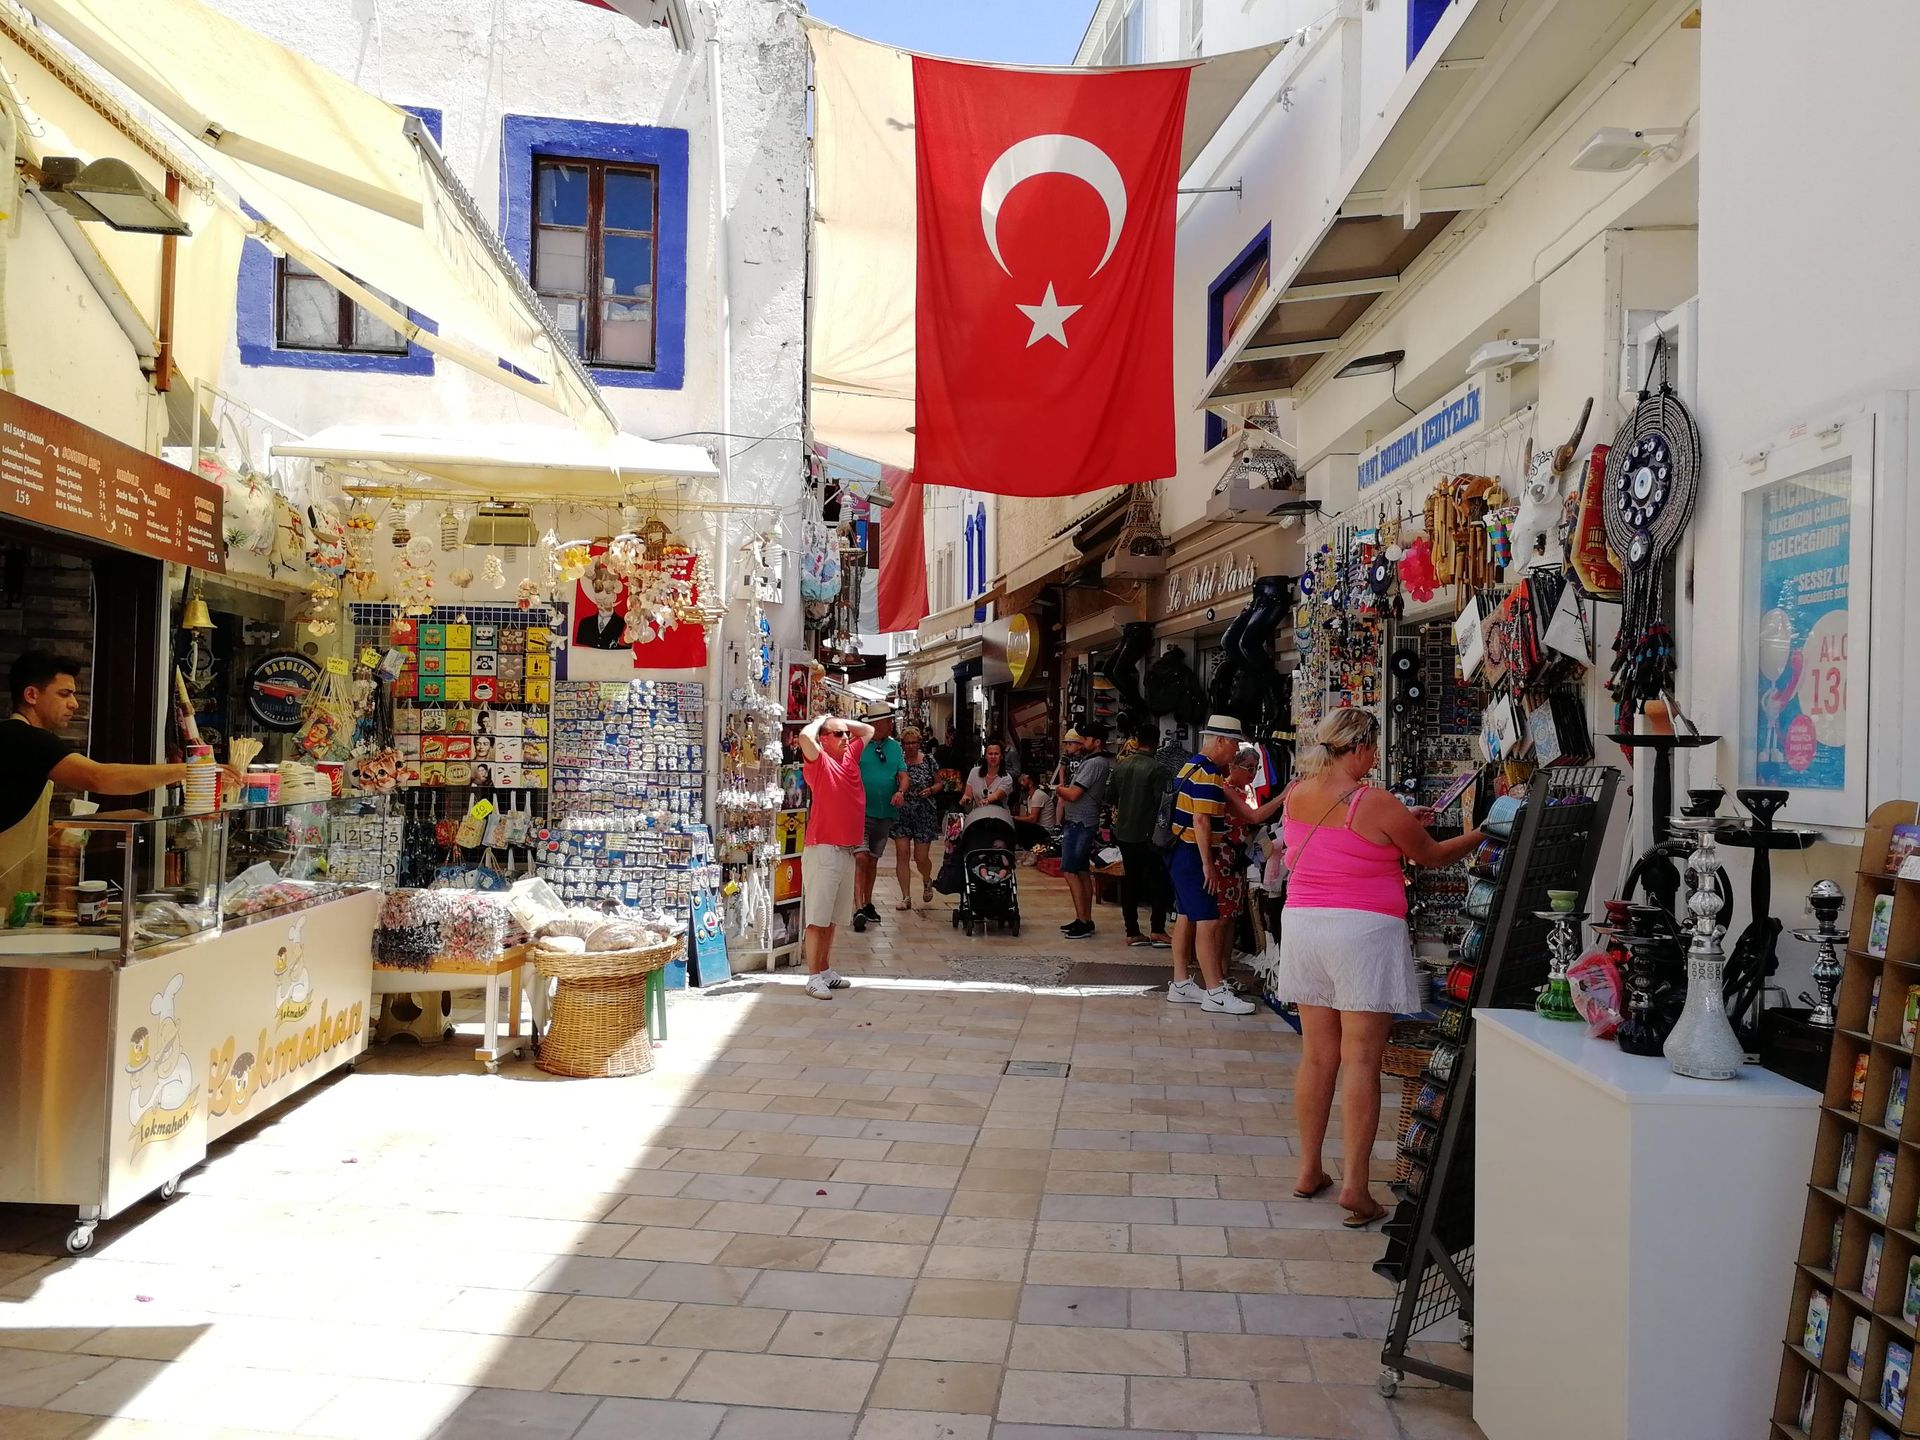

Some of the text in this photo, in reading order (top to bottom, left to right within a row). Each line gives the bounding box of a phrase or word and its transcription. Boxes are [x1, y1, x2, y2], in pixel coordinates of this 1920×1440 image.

[1166, 551, 1255, 614] Le Petit Paris
[264, 661, 316, 682] GASOLINE
[1811, 666, 1847, 715] 13
[348, 829, 358, 842] 2
[363, 830, 373, 843] 3
[388, 831, 399, 843] 5
